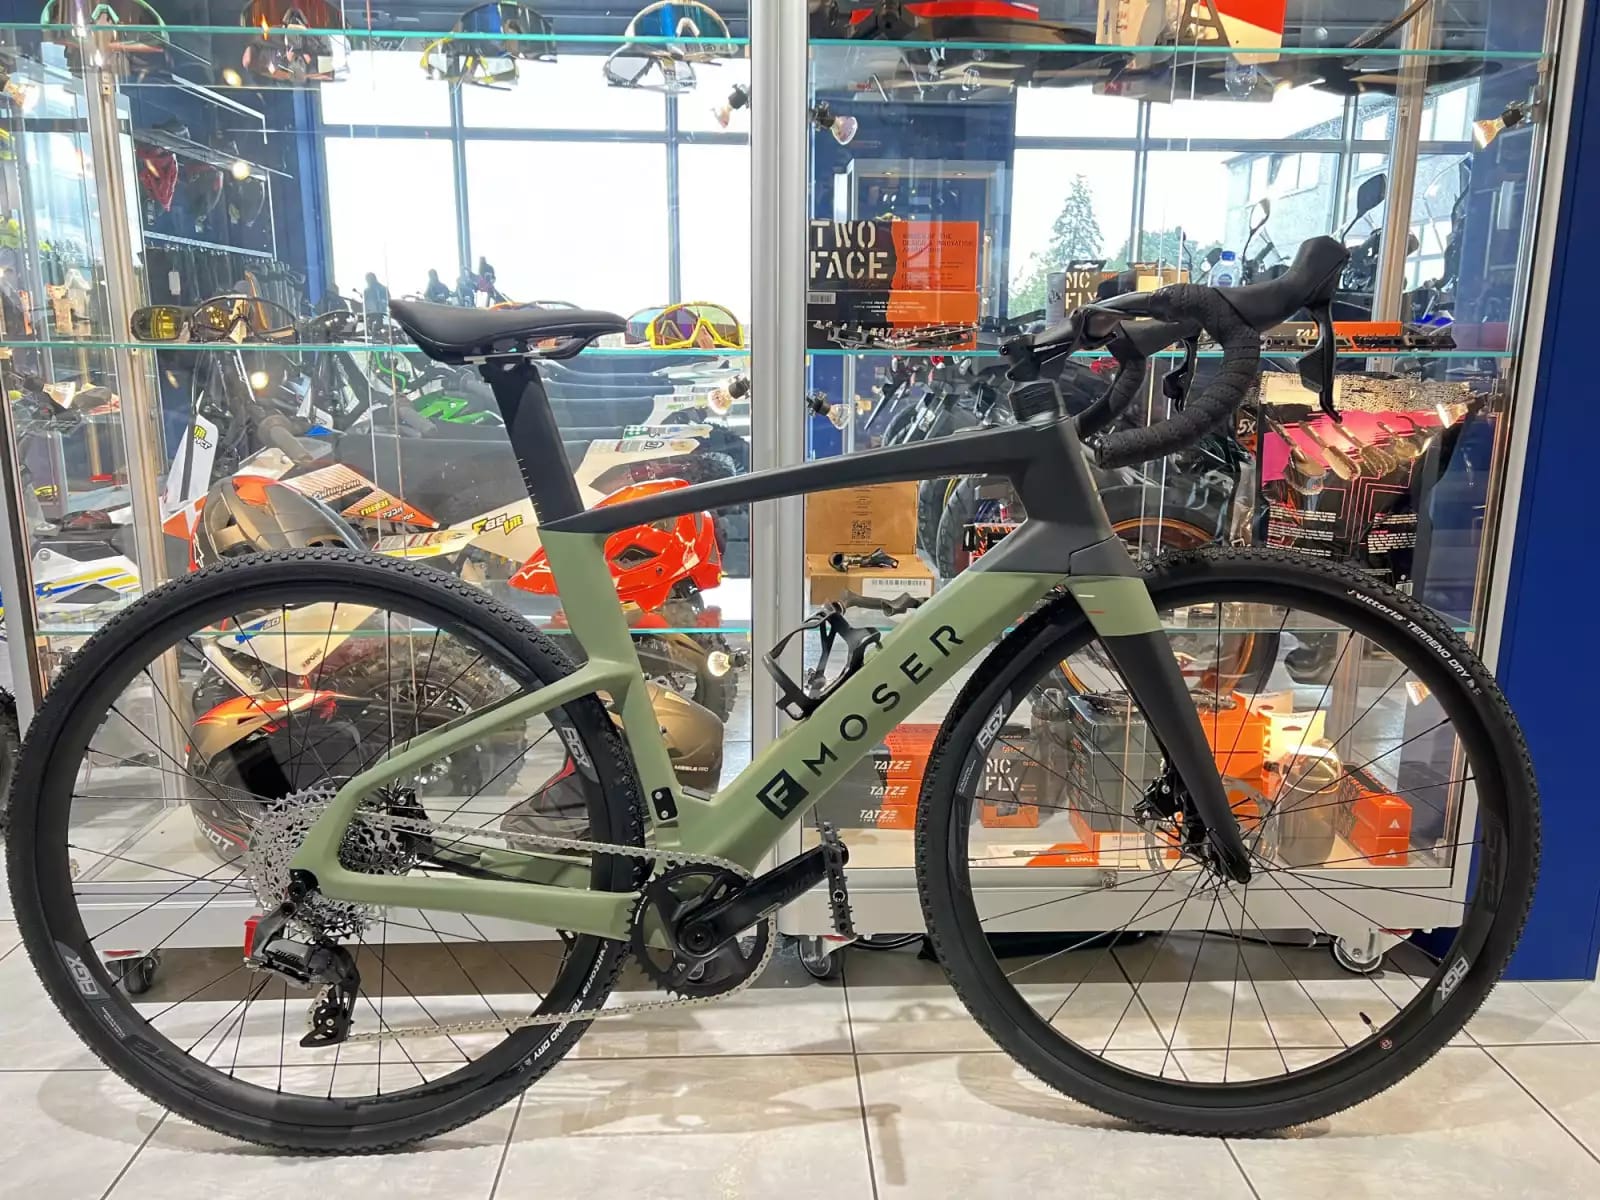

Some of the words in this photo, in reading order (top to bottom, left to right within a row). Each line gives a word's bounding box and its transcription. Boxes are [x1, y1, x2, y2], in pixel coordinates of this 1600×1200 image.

[810, 220, 876, 248] TWO
[810, 252, 888, 279] FACE
[1065, 271, 1091, 289] MC
[1407, 621, 1451, 659] TERRENO
[1447, 655, 1471, 679] DRY
[801, 625, 964, 778] MOSER
[873, 760, 913, 770] TATZE
[985, 758, 1012, 774] MC
[869, 785, 910, 796] TATZE
[985, 776, 1019, 792] FLY
[859, 809, 899, 819] TATZE
[533, 1039, 551, 1061] DRY
